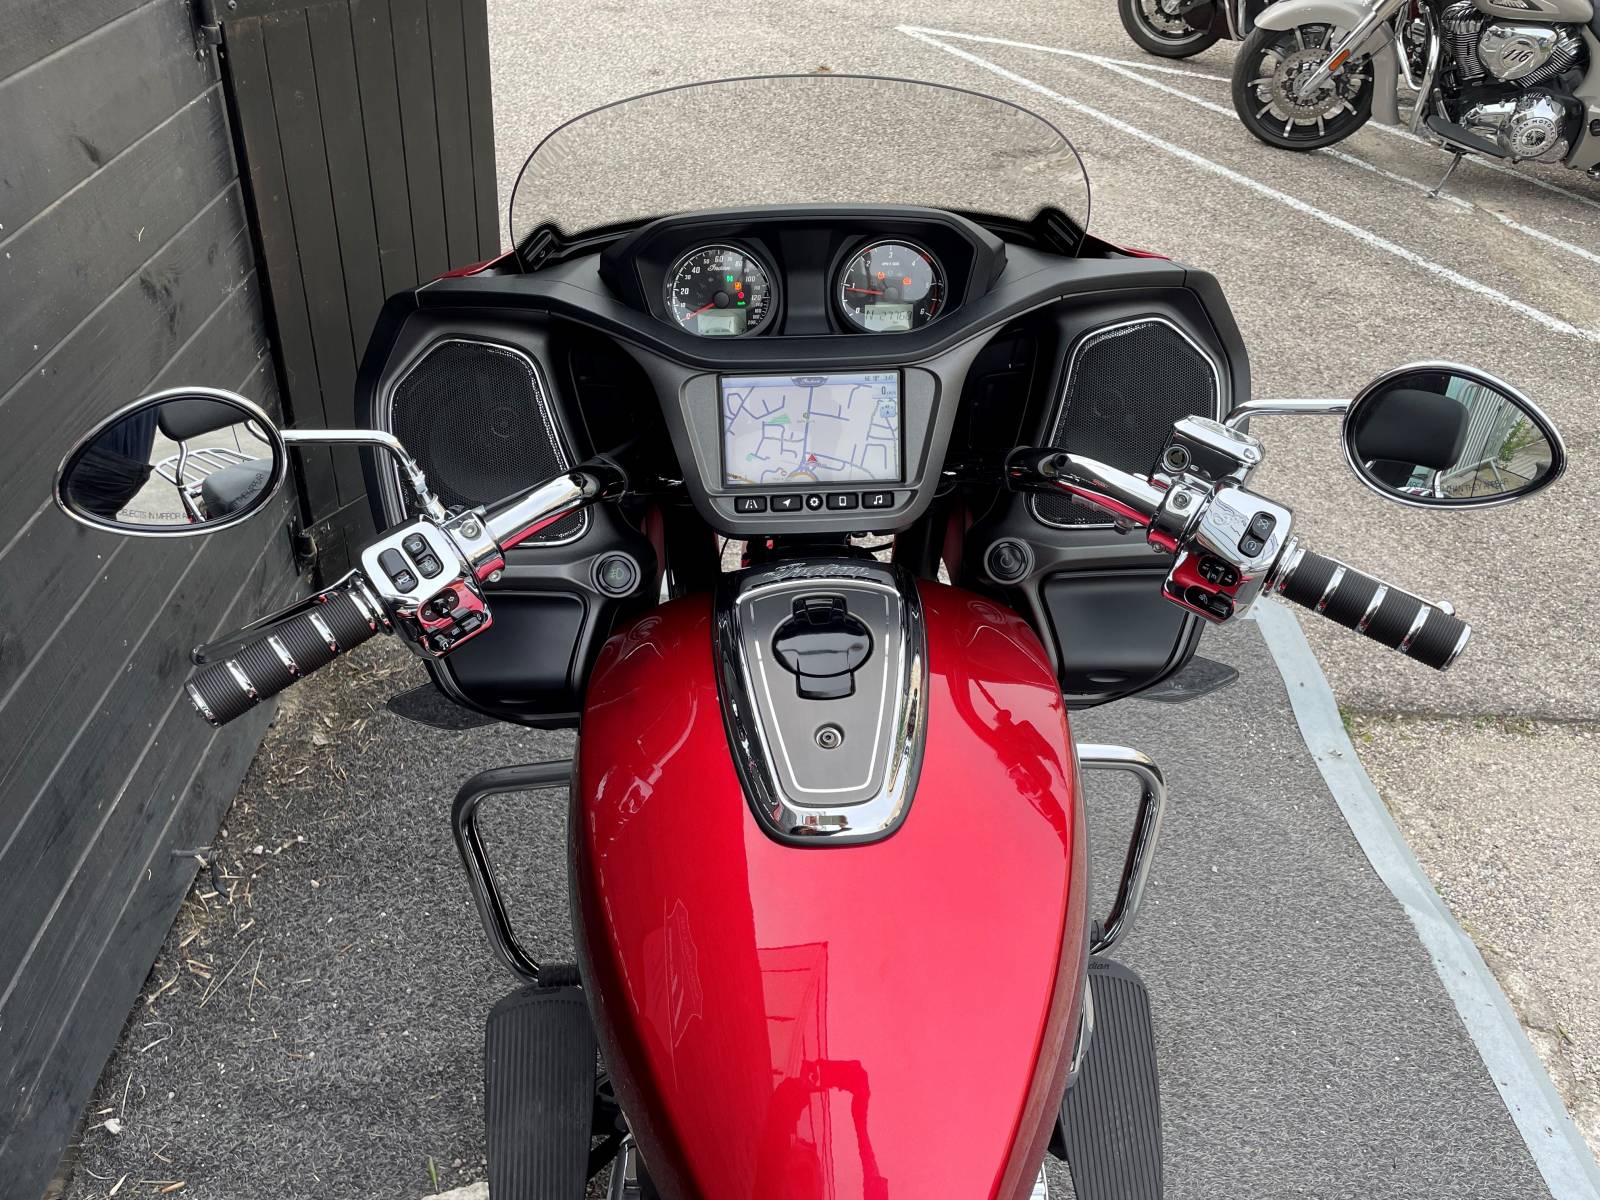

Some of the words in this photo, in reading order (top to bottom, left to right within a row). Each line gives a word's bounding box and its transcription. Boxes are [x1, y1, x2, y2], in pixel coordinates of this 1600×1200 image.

[1503, 49, 1534, 62] 116
[714, 255, 724, 263] 60
[691, 266, 701, 274] 40
[745, 275, 756, 283] 100
